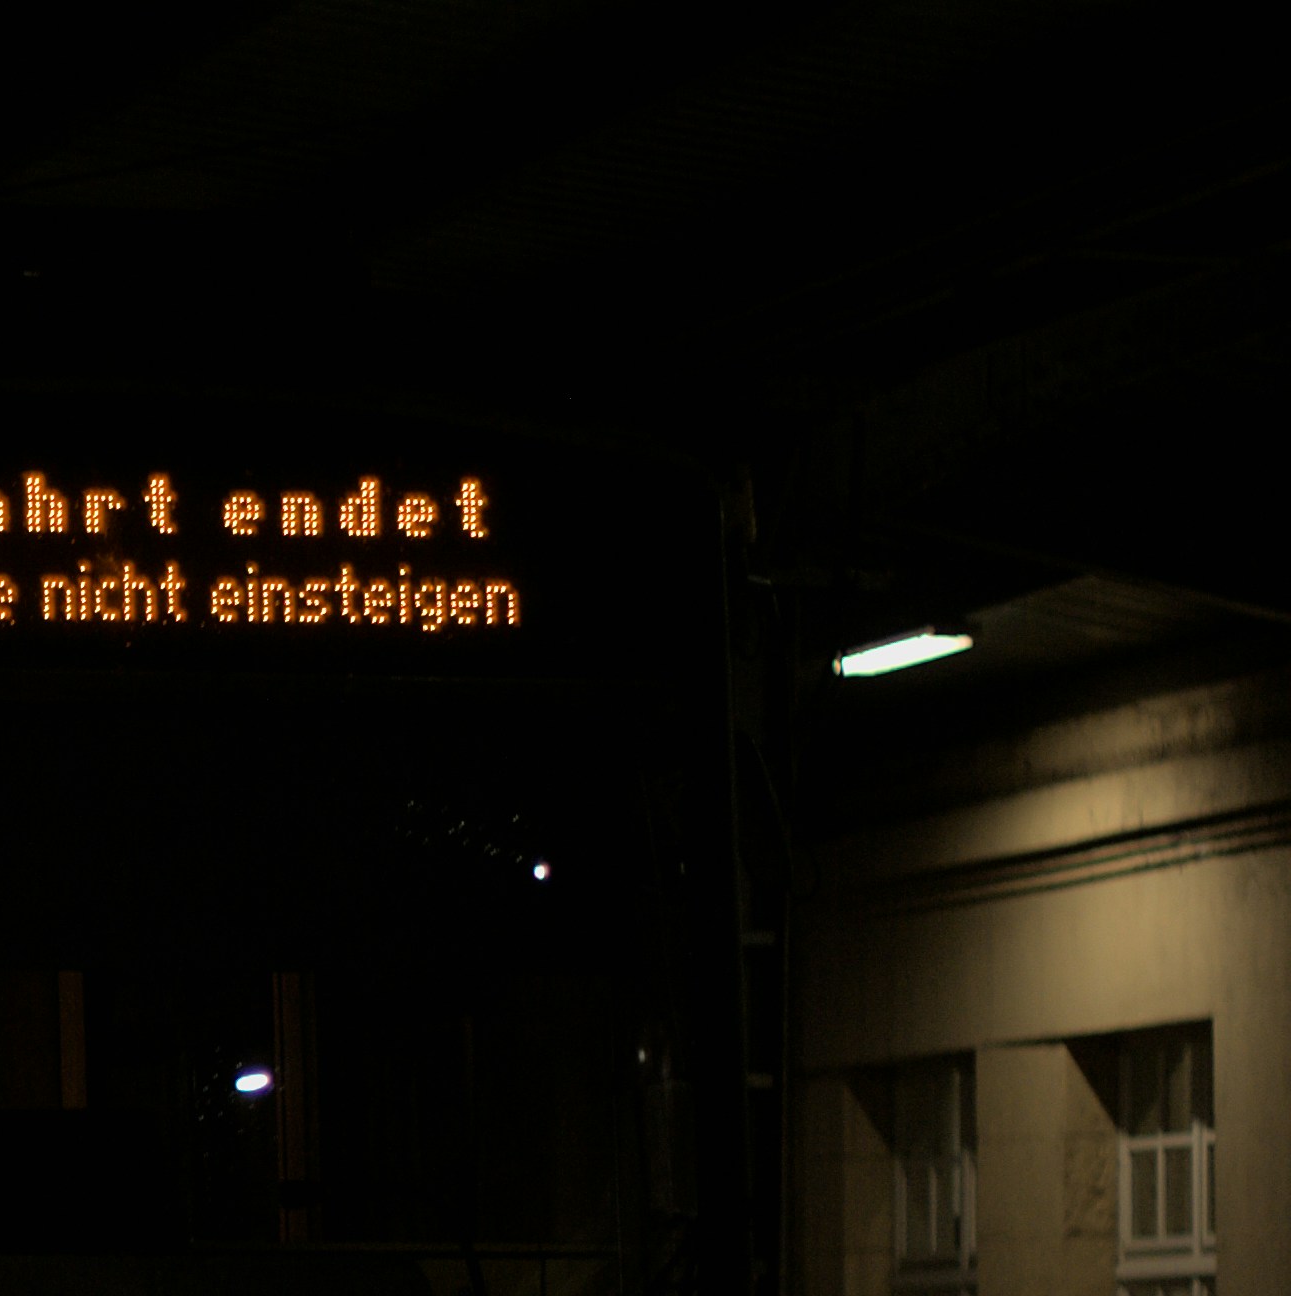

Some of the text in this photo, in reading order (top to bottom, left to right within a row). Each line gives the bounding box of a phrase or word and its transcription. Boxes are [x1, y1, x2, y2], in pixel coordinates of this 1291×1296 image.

[221, 474, 491, 538] endet
[39, 560, 187, 622] nicht
[210, 561, 521, 632] einsteigen
